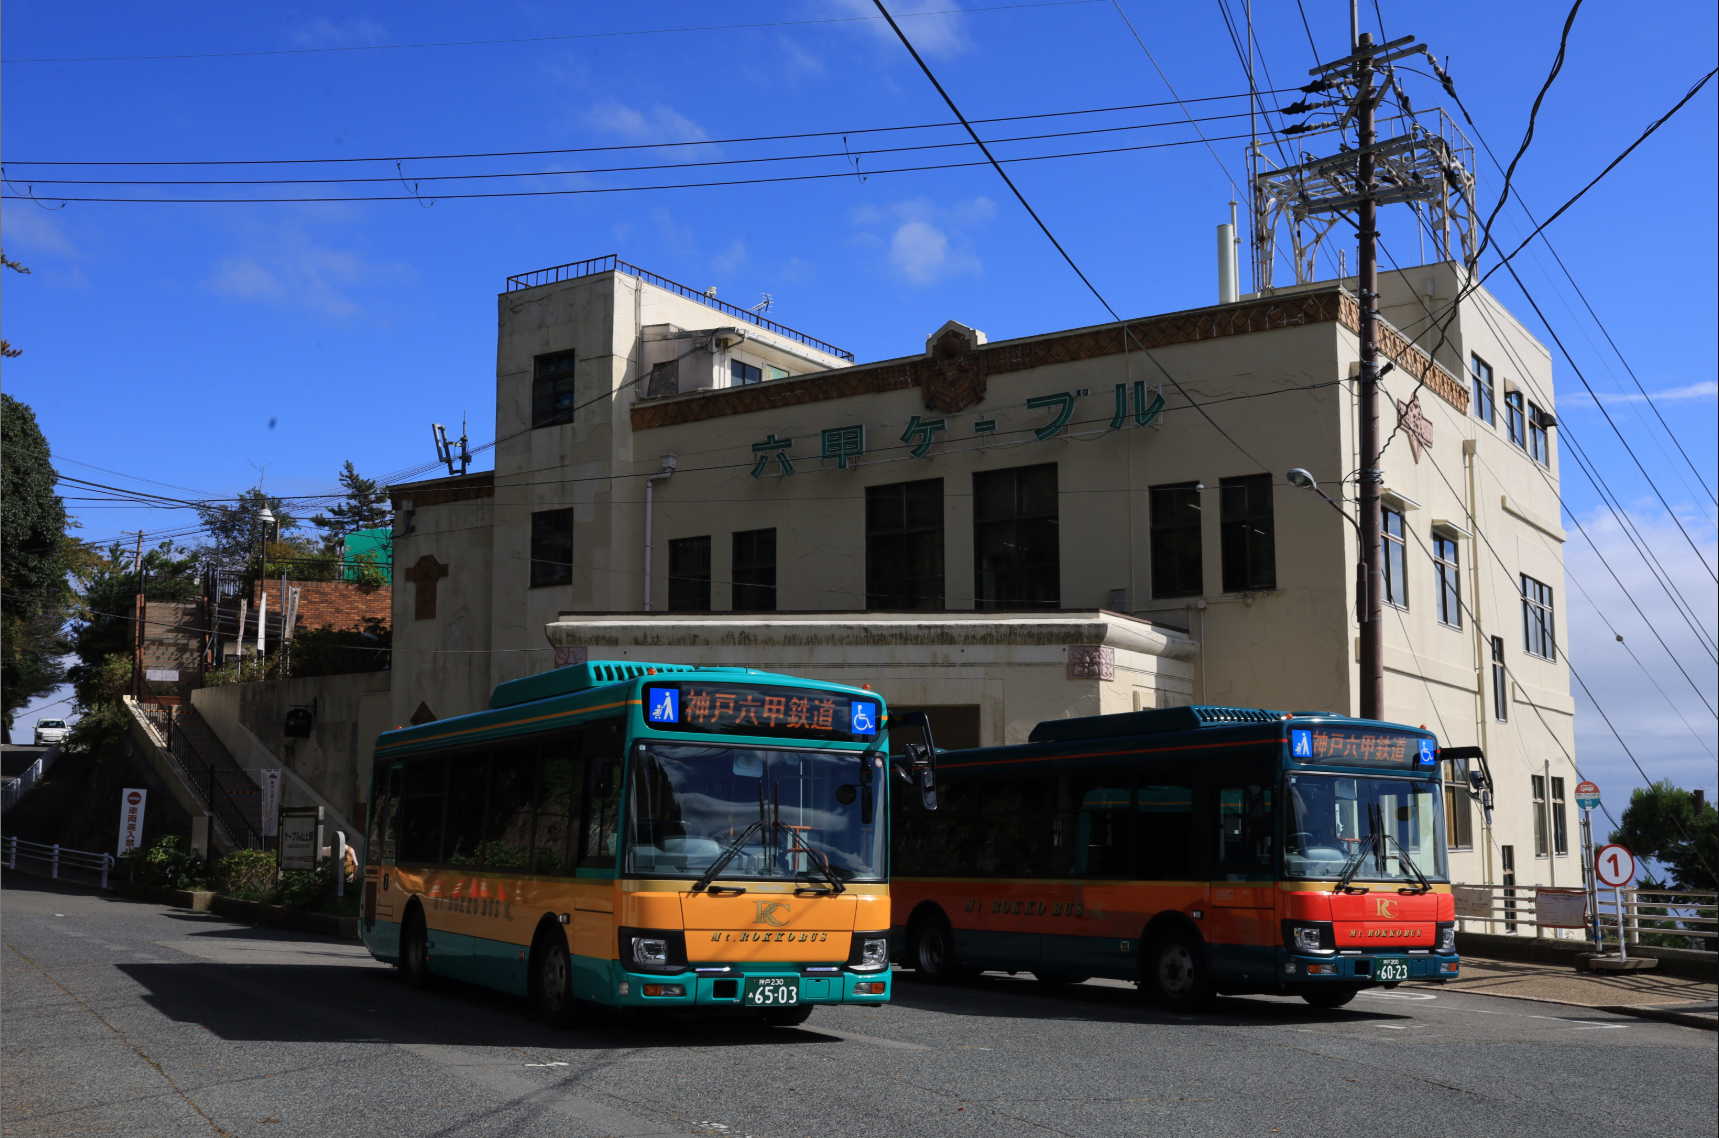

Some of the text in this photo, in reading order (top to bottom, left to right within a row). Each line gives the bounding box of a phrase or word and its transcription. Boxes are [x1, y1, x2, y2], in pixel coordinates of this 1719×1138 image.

[750, 380, 1166, 479] 六甲ケーブル
[685, 689, 836, 730] 神戸六甲鉄道
[1313, 730, 1407, 762] 神戸六甲鉄道
[1607, 853, 1620, 877] 1
[757, 884, 785, 892] ISUZU
[1051, 901, 1084, 918] BUS
[1381, 964, 1408, 980] 60-23
[754, 985, 798, 1004] 65-03
